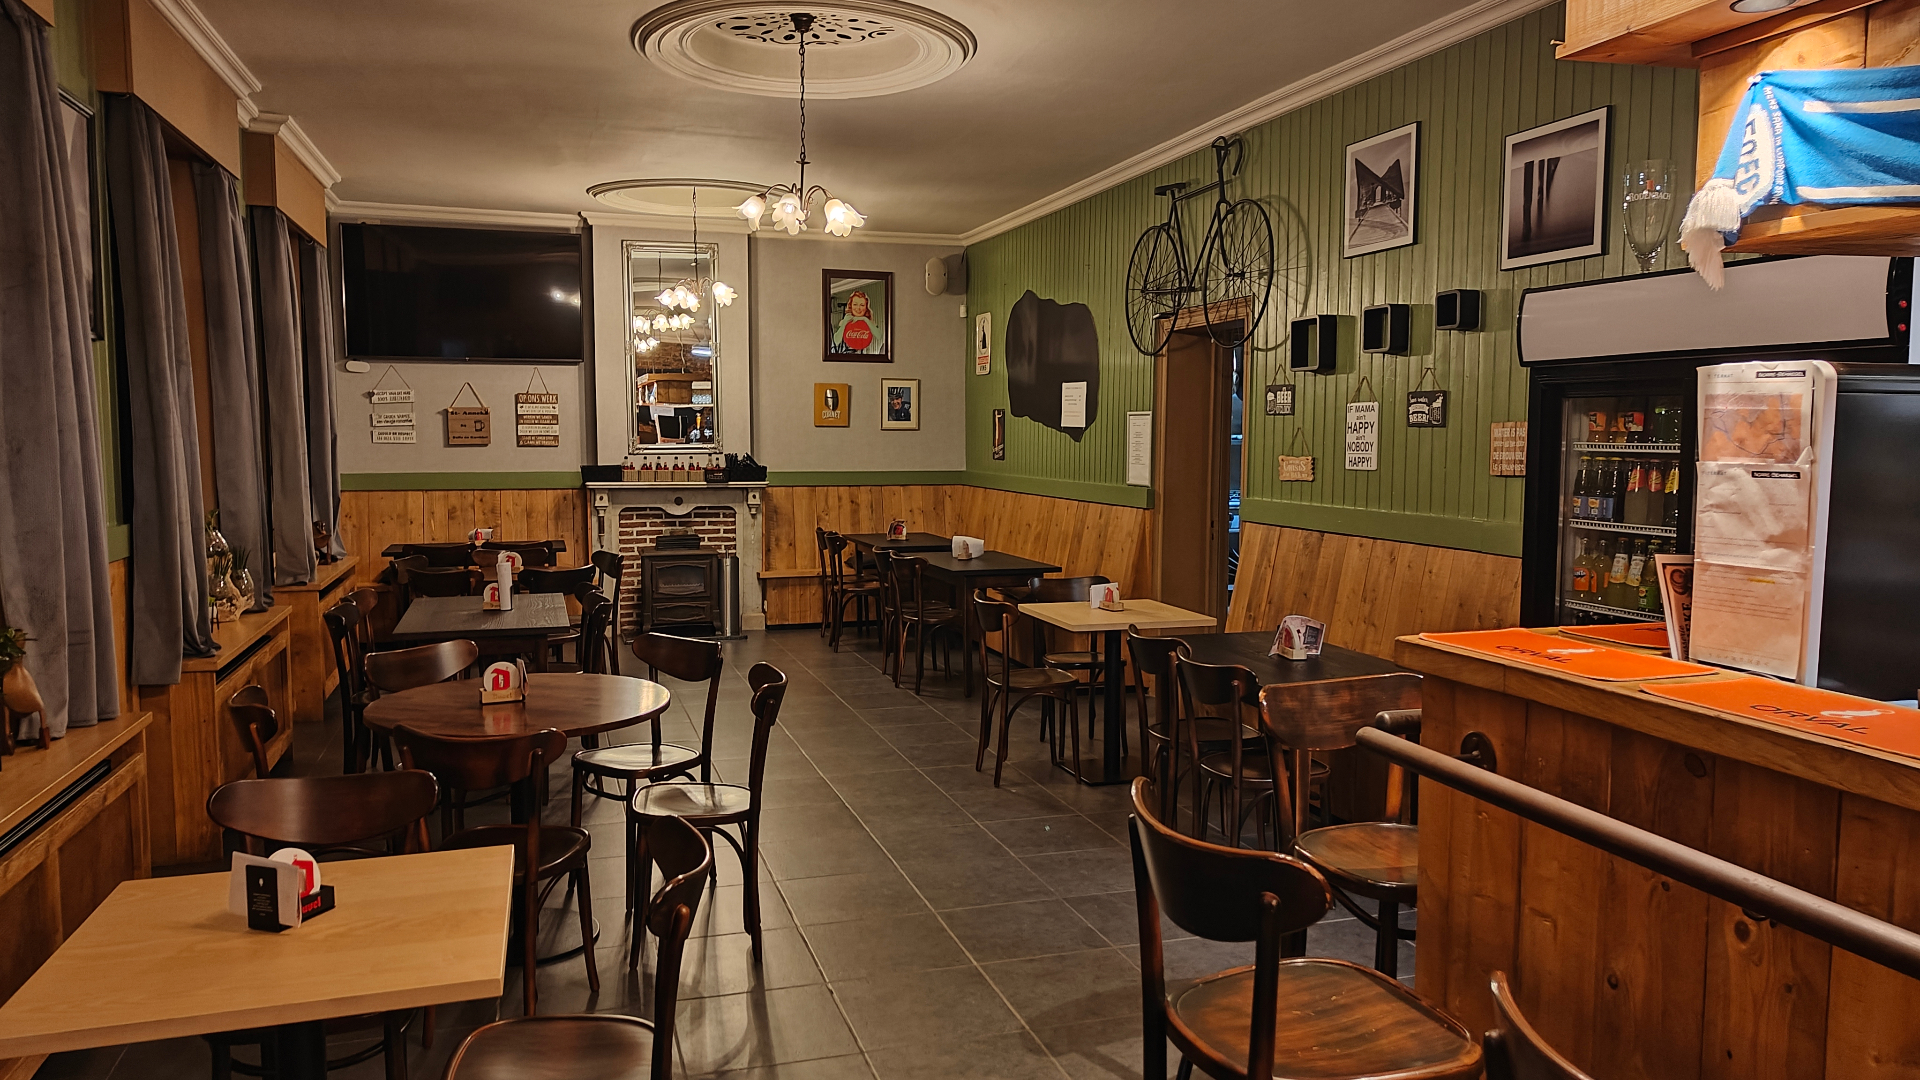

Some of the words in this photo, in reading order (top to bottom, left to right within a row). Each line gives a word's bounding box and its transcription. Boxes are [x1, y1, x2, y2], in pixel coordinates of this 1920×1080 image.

[1771, 111, 1783, 135] SANA
[528, 394, 539, 403] ONS
[541, 394, 557, 403] WERK
[1276, 391, 1291, 403] BEER
[1347, 405, 1353, 413] IF
[1355, 404, 1375, 413] MAMA
[1409, 413, 1429, 422] BEER!
[1347, 421, 1375, 434] HAPPY
[1347, 441, 1374, 452] NOBODY
[1348, 456, 1372, 468] HAPPY!
[1750, 704, 1869, 735] ORVAL
[302, 895, 321, 913] uvel
